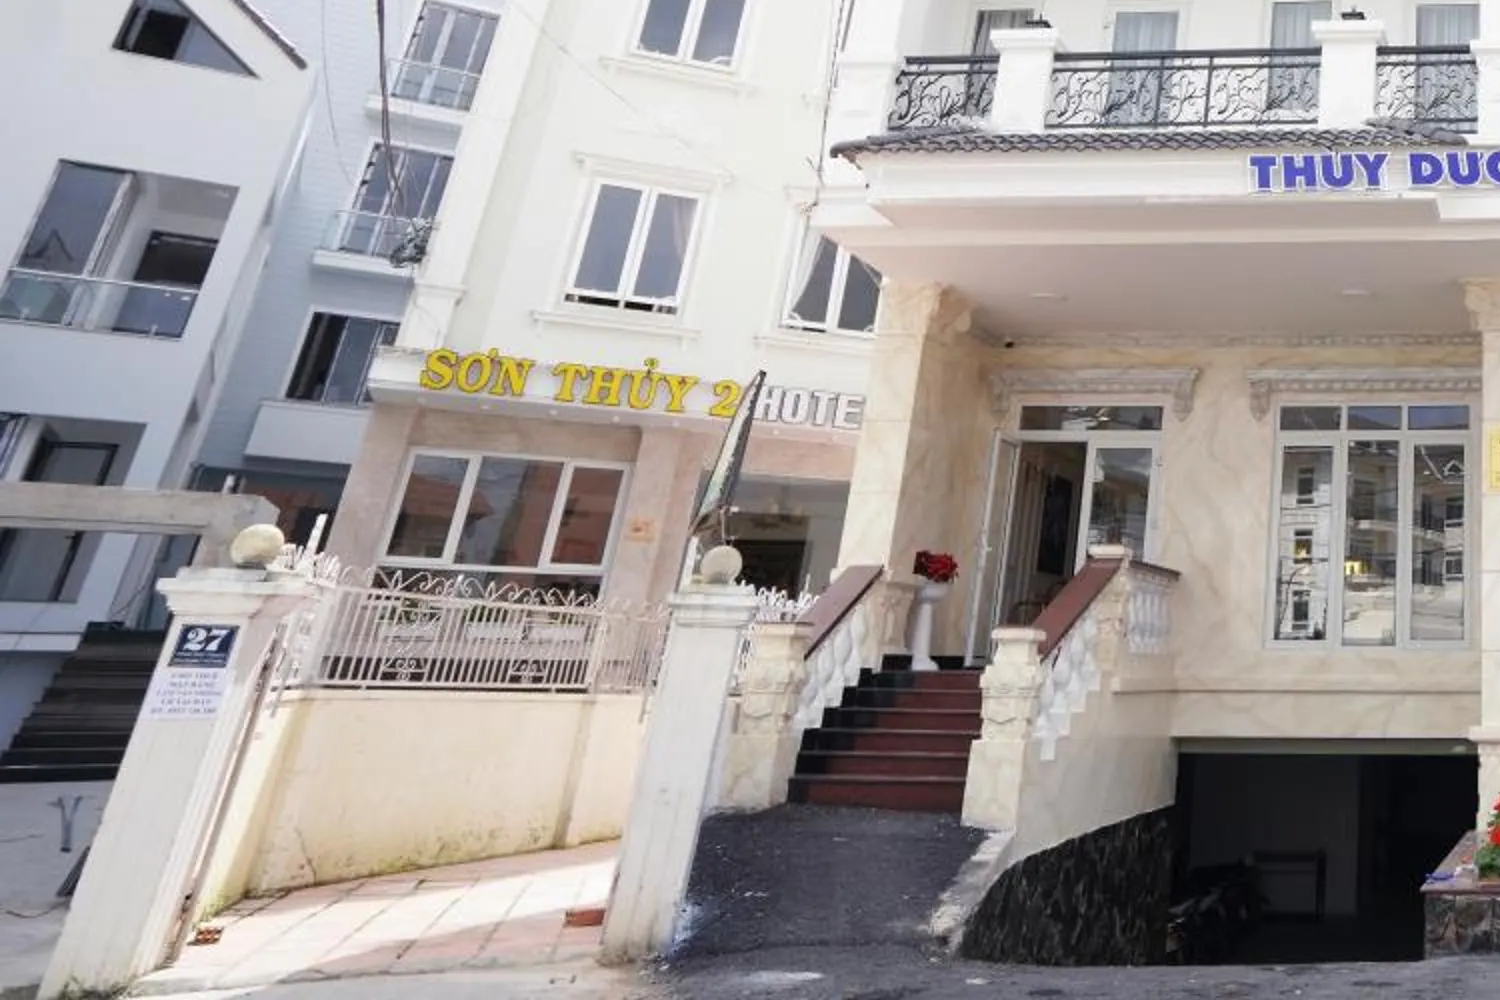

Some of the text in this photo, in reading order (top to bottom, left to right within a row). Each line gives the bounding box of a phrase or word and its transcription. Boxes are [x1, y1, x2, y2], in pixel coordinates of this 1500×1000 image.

[418, 347, 742, 418] SƠN THỦY 2
[182, 627, 231, 652] 27
